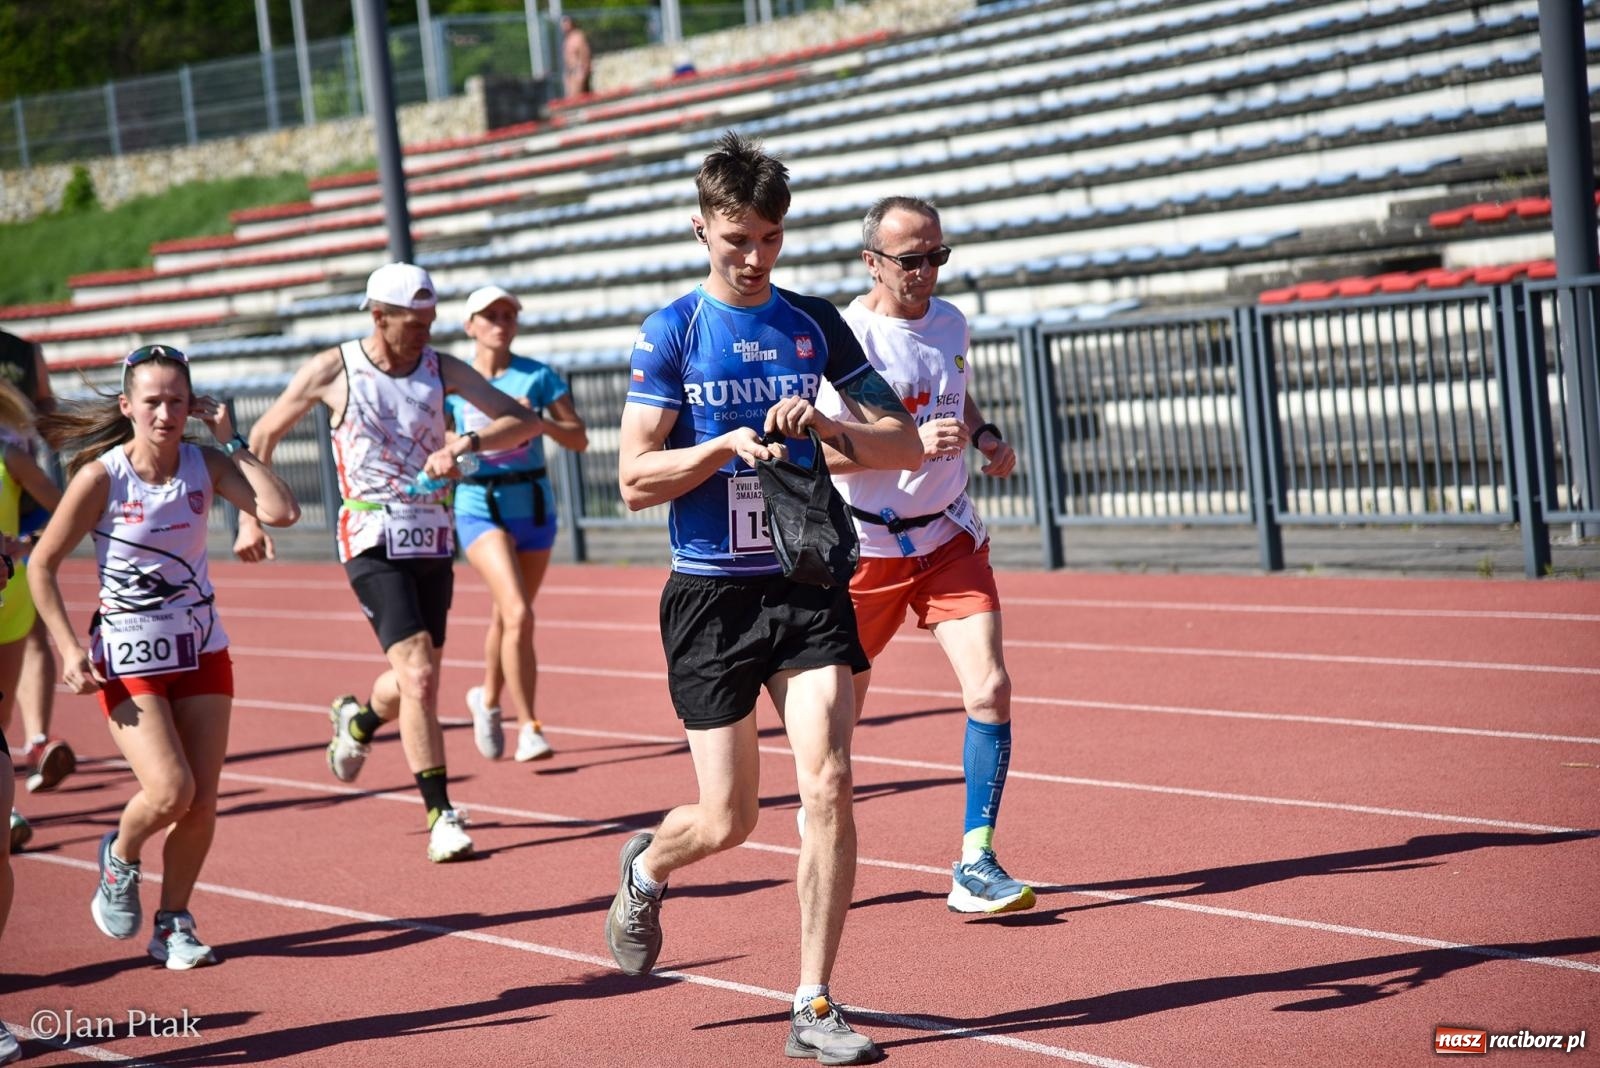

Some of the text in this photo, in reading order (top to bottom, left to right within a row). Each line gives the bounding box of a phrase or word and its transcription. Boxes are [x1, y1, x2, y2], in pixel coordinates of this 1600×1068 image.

[683, 373, 818, 407] RUNNER
[935, 392, 960, 407] BIEG
[713, 408, 767, 421] EKO-OKN
[735, 482, 752, 491] XVIII
[735, 491, 764, 500] 3MAJA2
[397, 528, 434, 548] 203
[118, 637, 171, 665] 230
